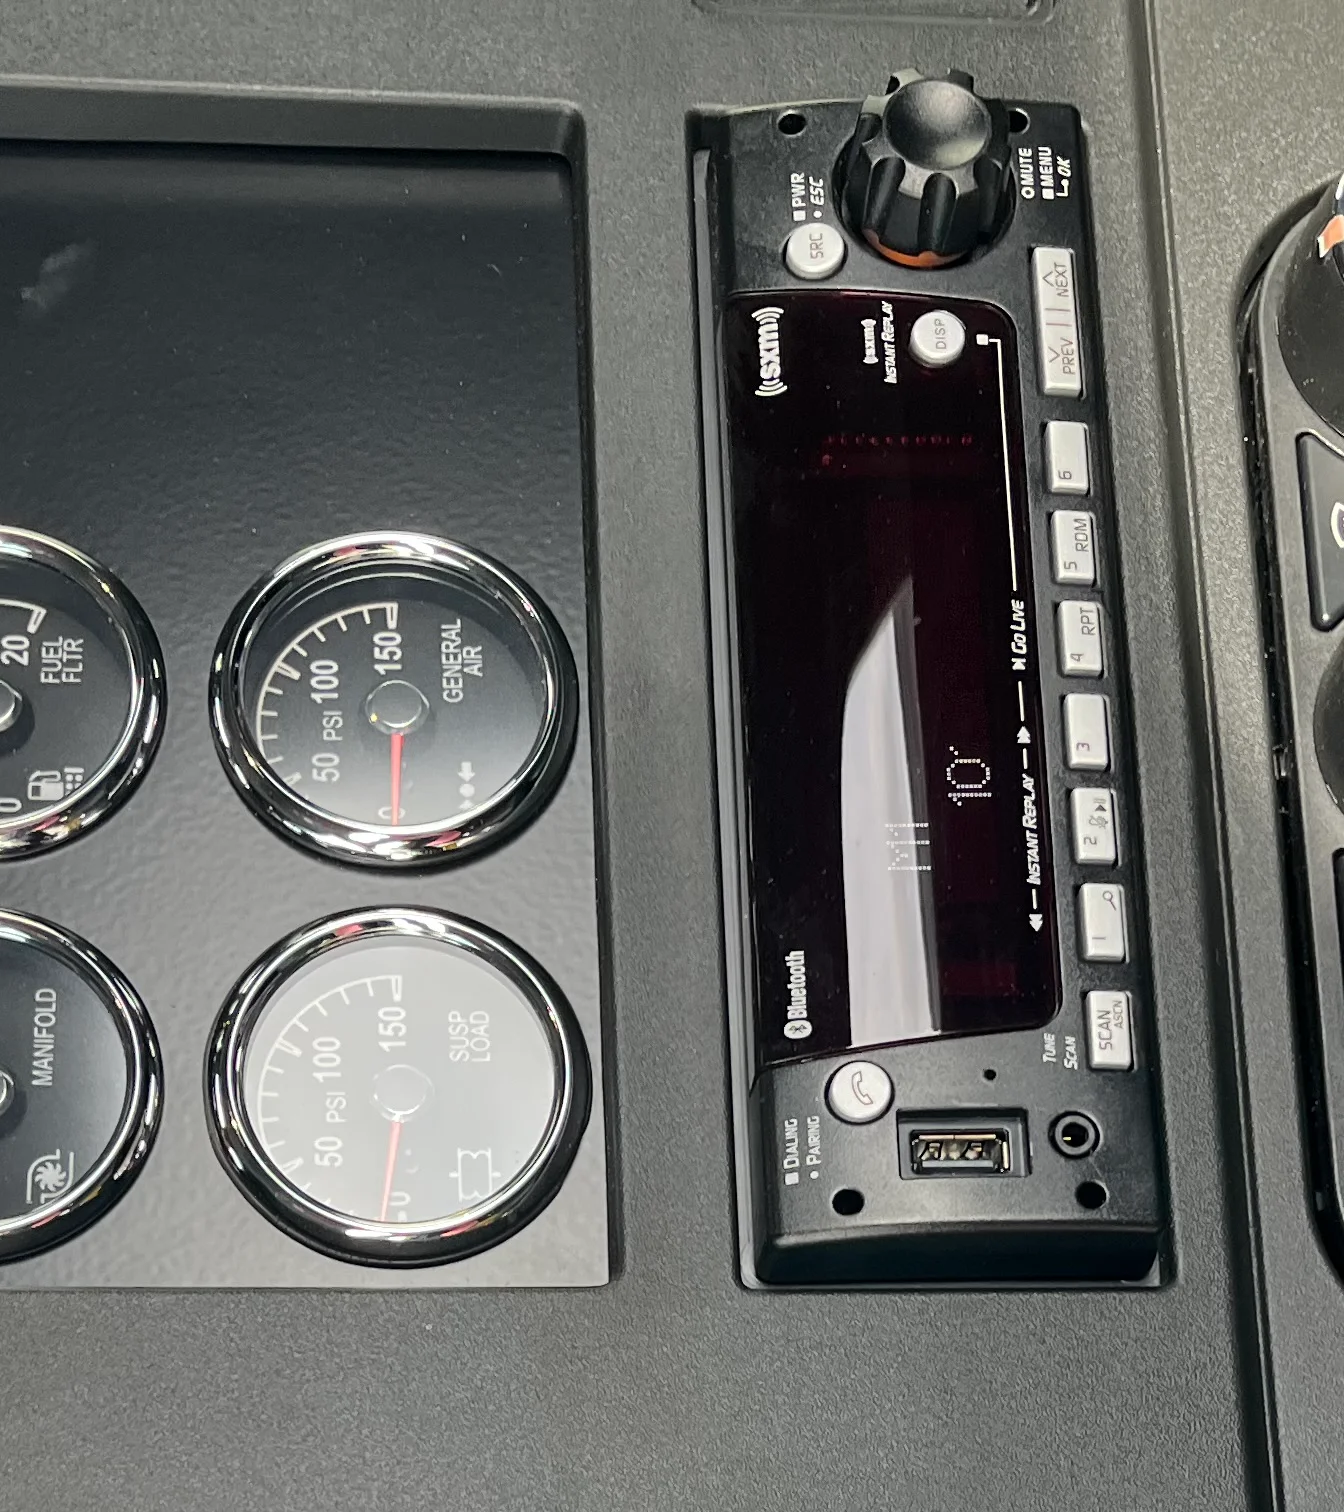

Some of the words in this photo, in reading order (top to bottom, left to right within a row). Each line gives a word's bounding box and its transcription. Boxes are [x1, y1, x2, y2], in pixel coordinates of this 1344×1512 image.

[1018, 147, 1033, 188] MUTE
[1037, 146, 1054, 188] MENU
[1057, 156, 1072, 180] OK
[790, 172, 807, 208] PWR
[808, 176, 825, 206] ESC
[809, 232, 824, 260] SRC
[1054, 262, 1070, 298] NEXT
[933, 318, 947, 350] DISP
[1060, 337, 1076, 375] PREV
[1058, 469, 1073, 480] 6
[1073, 518, 1090, 552] RDM
[1063, 560, 1078, 571] 5
[1080, 607, 1096, 636] RPT
[0, 633, 31, 666] 20
[40, 635, 64, 684] FUEL
[61, 637, 85, 683] FLTR
[372, 630, 403, 676] 150
[440, 617, 465, 704] GENERAL
[463, 645, 484, 678] AIR
[1071, 653, 1084, 662] 4
[309, 658, 340, 704] 100
[322, 710, 344, 742] PSI
[1076, 741, 1090, 752] 3
[312, 752, 340, 784] 50
[1083, 836, 1098, 846] 2
[784, 950, 808, 1020] Bluetooth
[377, 1005, 407, 1053] 150
[1097, 1009, 1113, 1051] SCAN
[1112, 999, 1124, 1030] ASCN
[31, 987, 57, 1088] MANIFOLD
[448, 1010, 471, 1063] SUSP
[469, 1009, 492, 1063] LOAD
[312, 1036, 342, 1083] 100
[325, 1091, 347, 1124] PSI
[313, 1135, 344, 1168] 50
